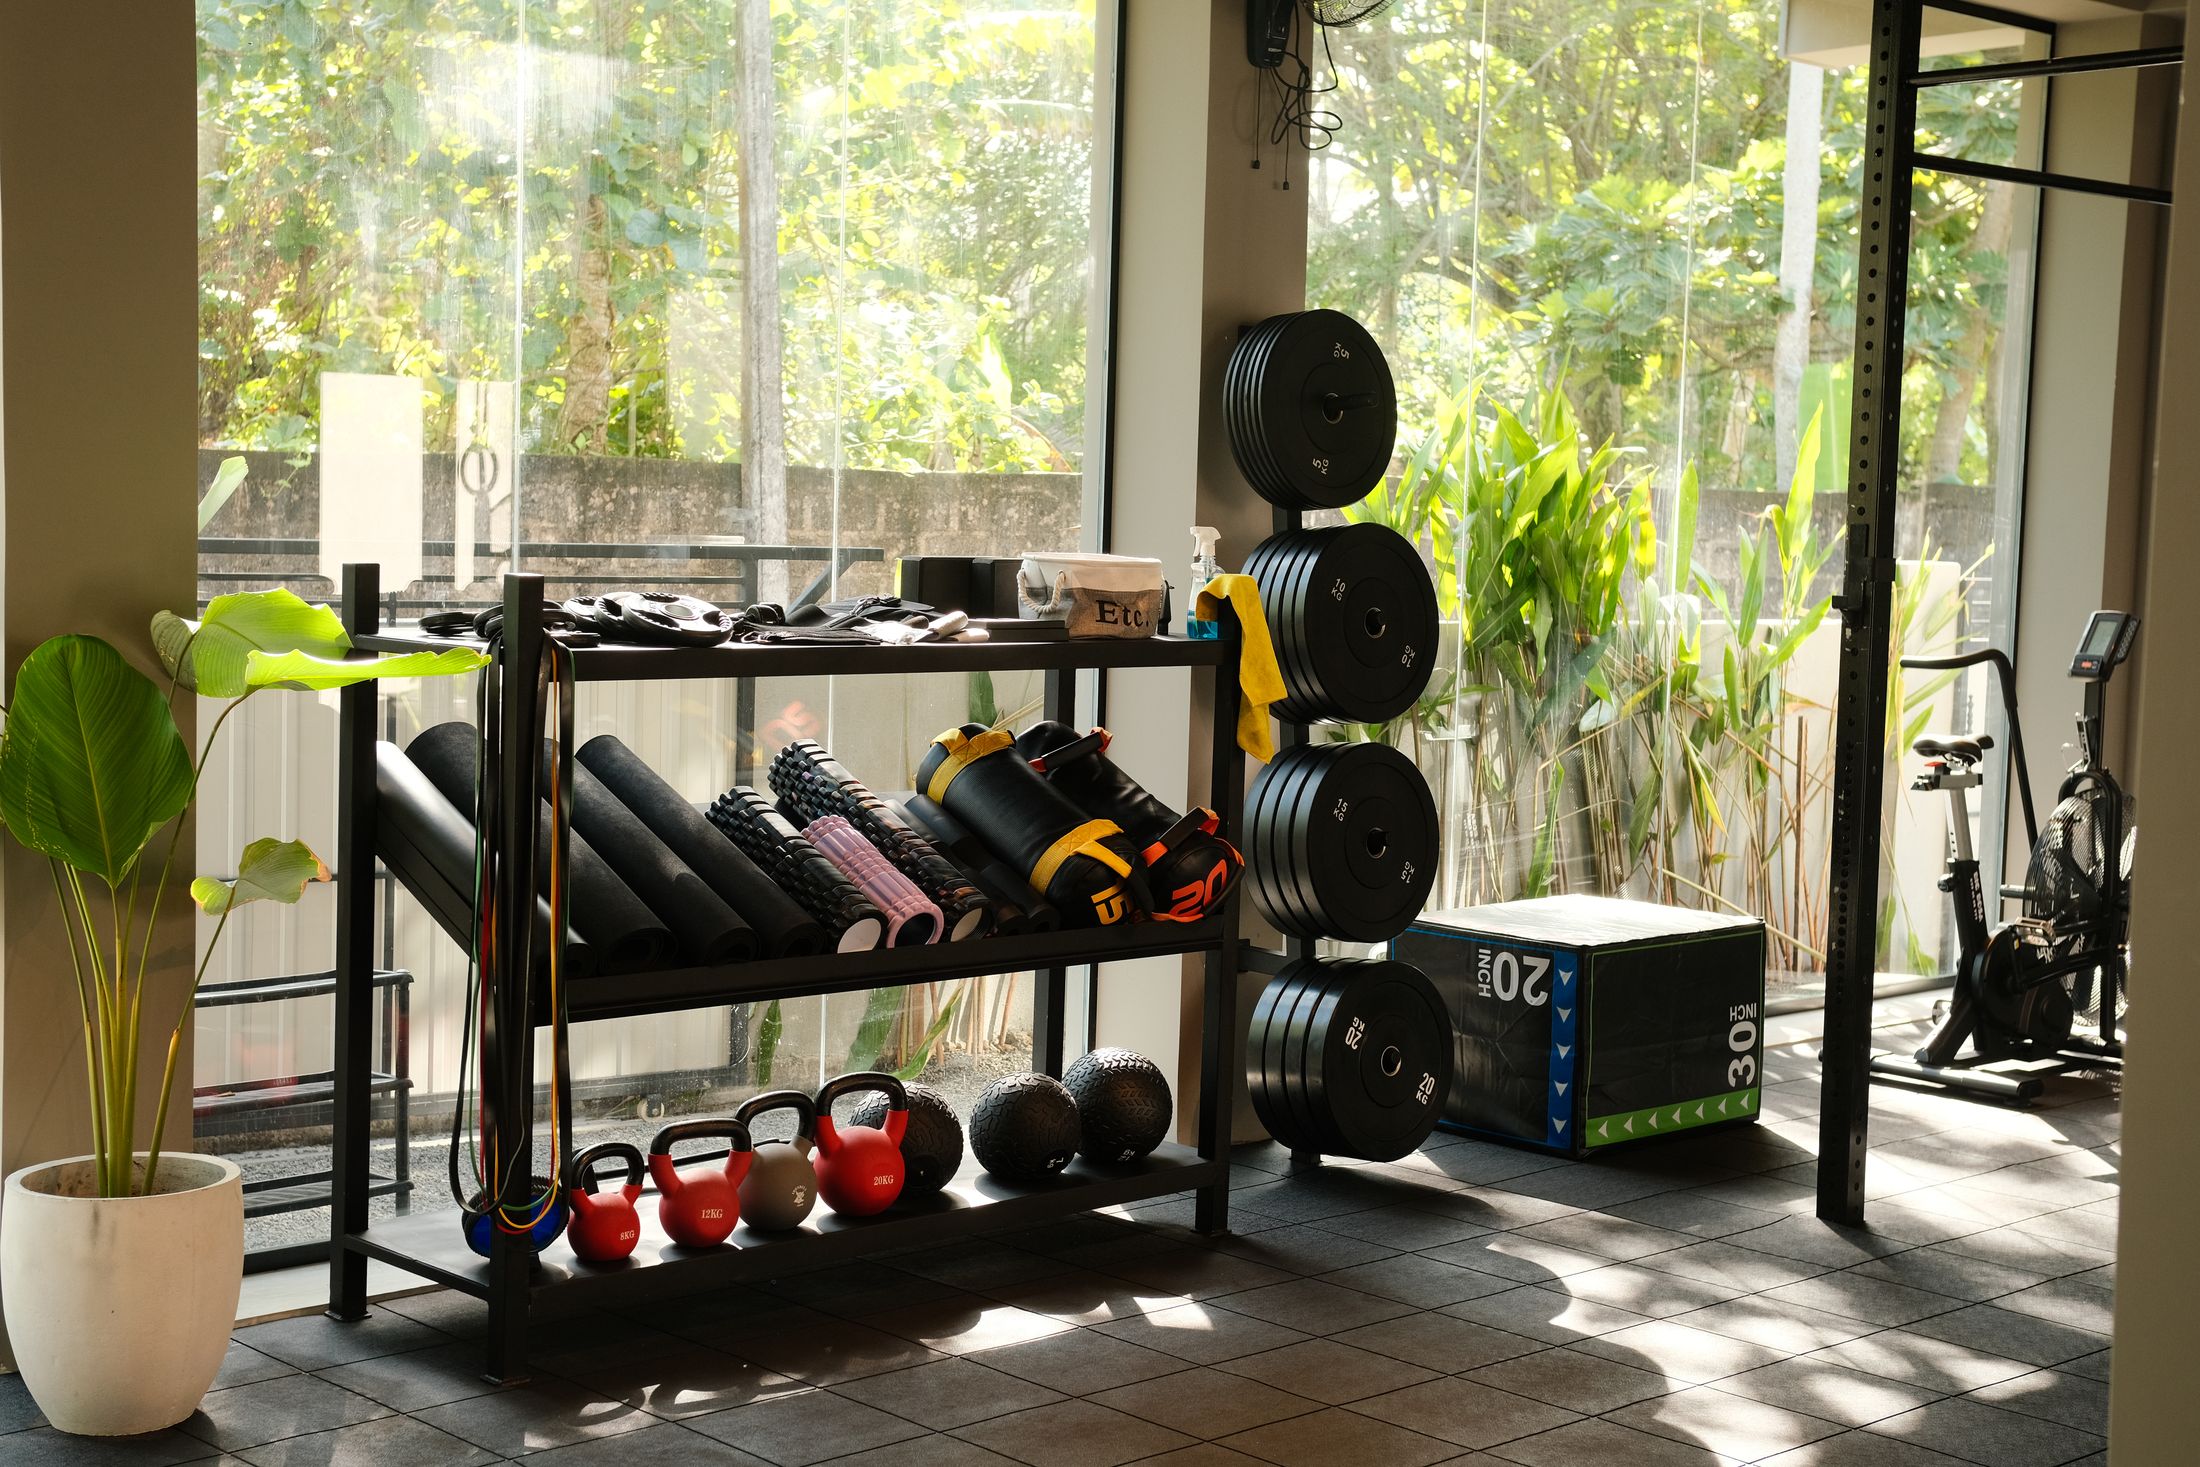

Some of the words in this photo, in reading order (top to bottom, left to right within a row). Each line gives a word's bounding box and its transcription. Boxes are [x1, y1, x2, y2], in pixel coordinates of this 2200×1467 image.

[1335, 578, 1346, 592] 10
[1331, 587, 1342, 601] KG
[1096, 599, 1149, 628] Etc.
[1404, 645, 1416, 658] KG
[1401, 654, 1411, 668] 10
[1337, 798, 1348, 813] 15
[1333, 808, 1344, 821] KG
[1404, 861, 1415, 875] KG
[1400, 870, 1411, 884] 15
[1168, 858, 1227, 917] 20
[1477, 948, 1491, 998] INCH
[1492, 951, 1551, 1007] 20
[1729, 1003, 1757, 1021] INCH
[1352, 1016, 1366, 1032] KG
[1345, 1026, 1362, 1050] 20
[1728, 1021, 1757, 1088] 30
[1419, 1072, 1435, 1095] 20
[1415, 1090, 1428, 1105] KG
[873, 1175, 894, 1186] 20KG
[701, 1208, 723, 1219] 12KG
[620, 1230, 635, 1241] 8KG
